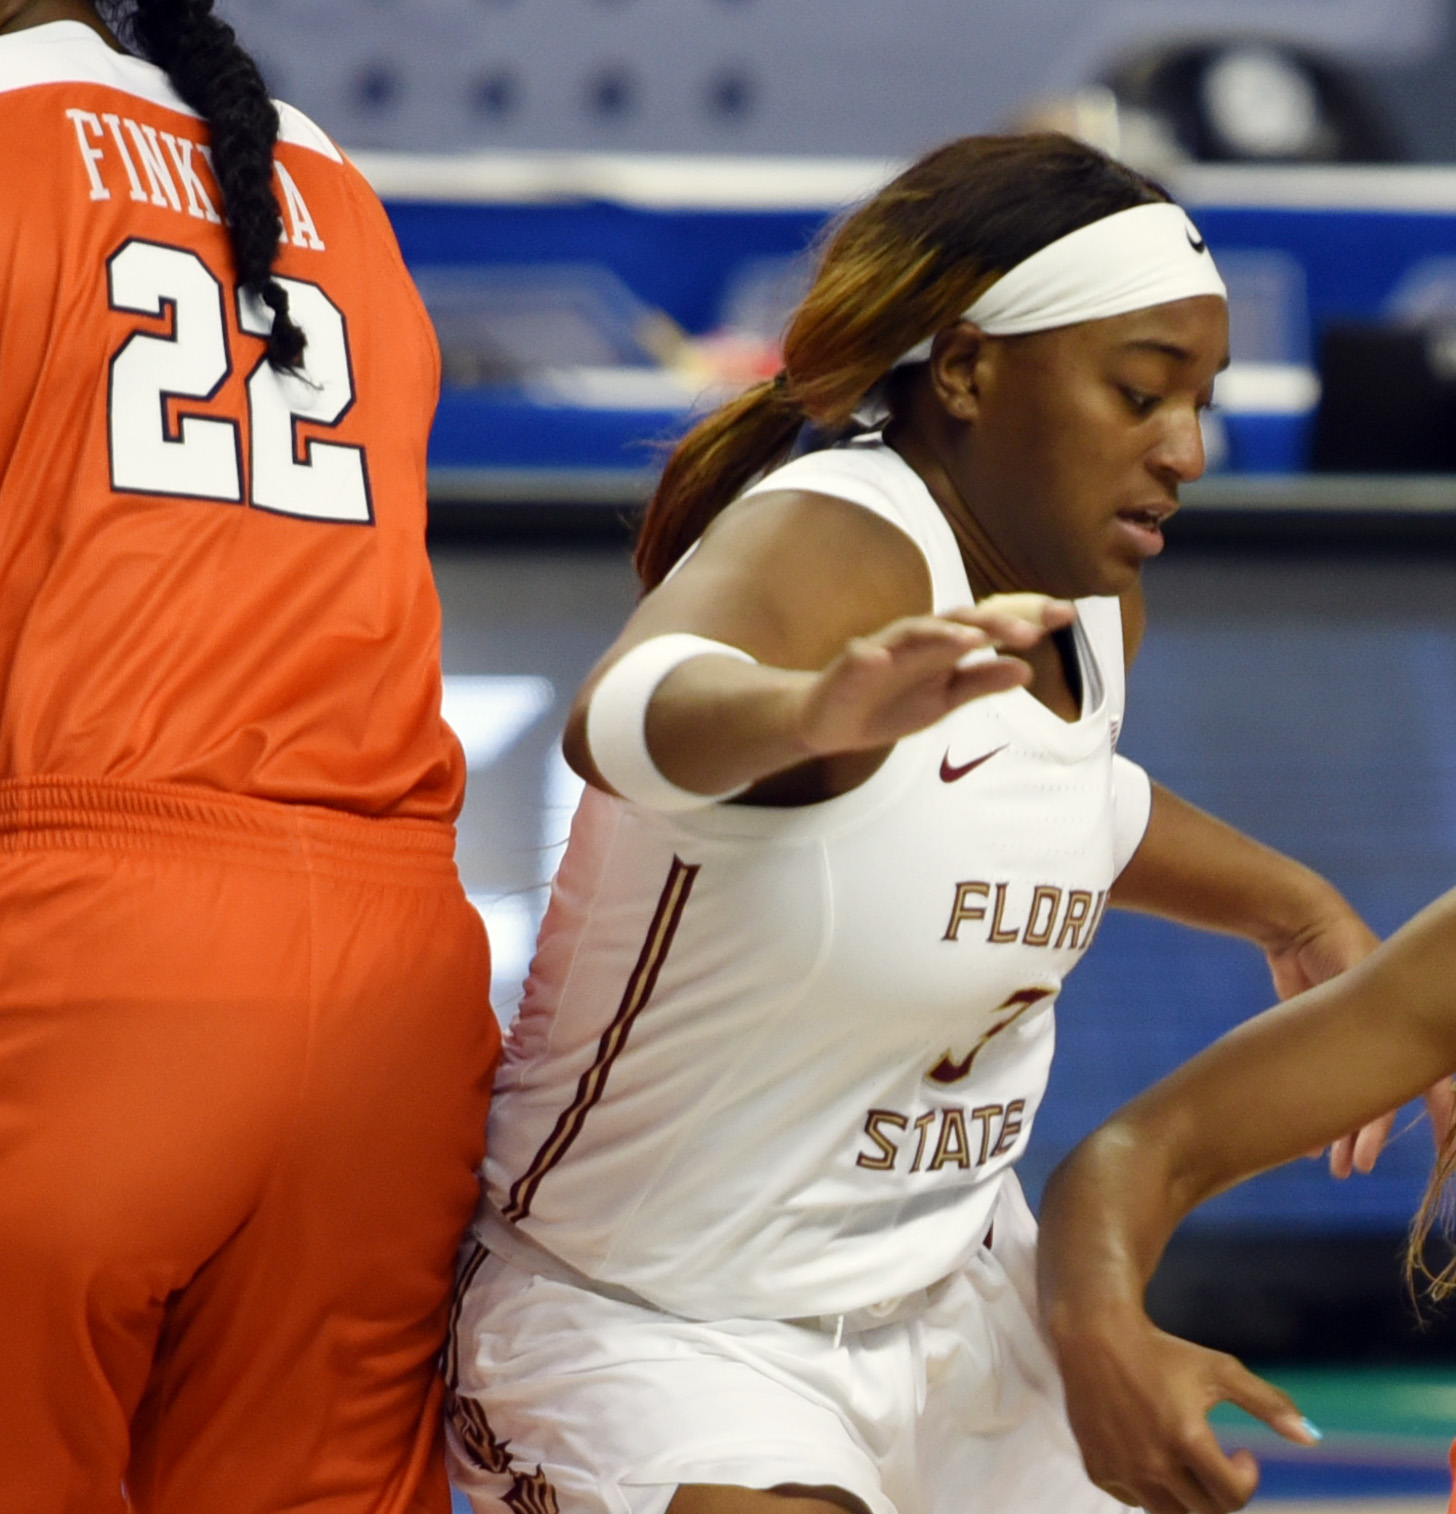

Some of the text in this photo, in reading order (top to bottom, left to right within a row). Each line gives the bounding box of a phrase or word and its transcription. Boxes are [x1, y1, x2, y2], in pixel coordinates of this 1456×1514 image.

[66, 107, 326, 252] FINKA
[105, 236, 376, 526] 22
[940, 880, 1109, 950] FLORI
[855, 1097, 1026, 1175] STATE
